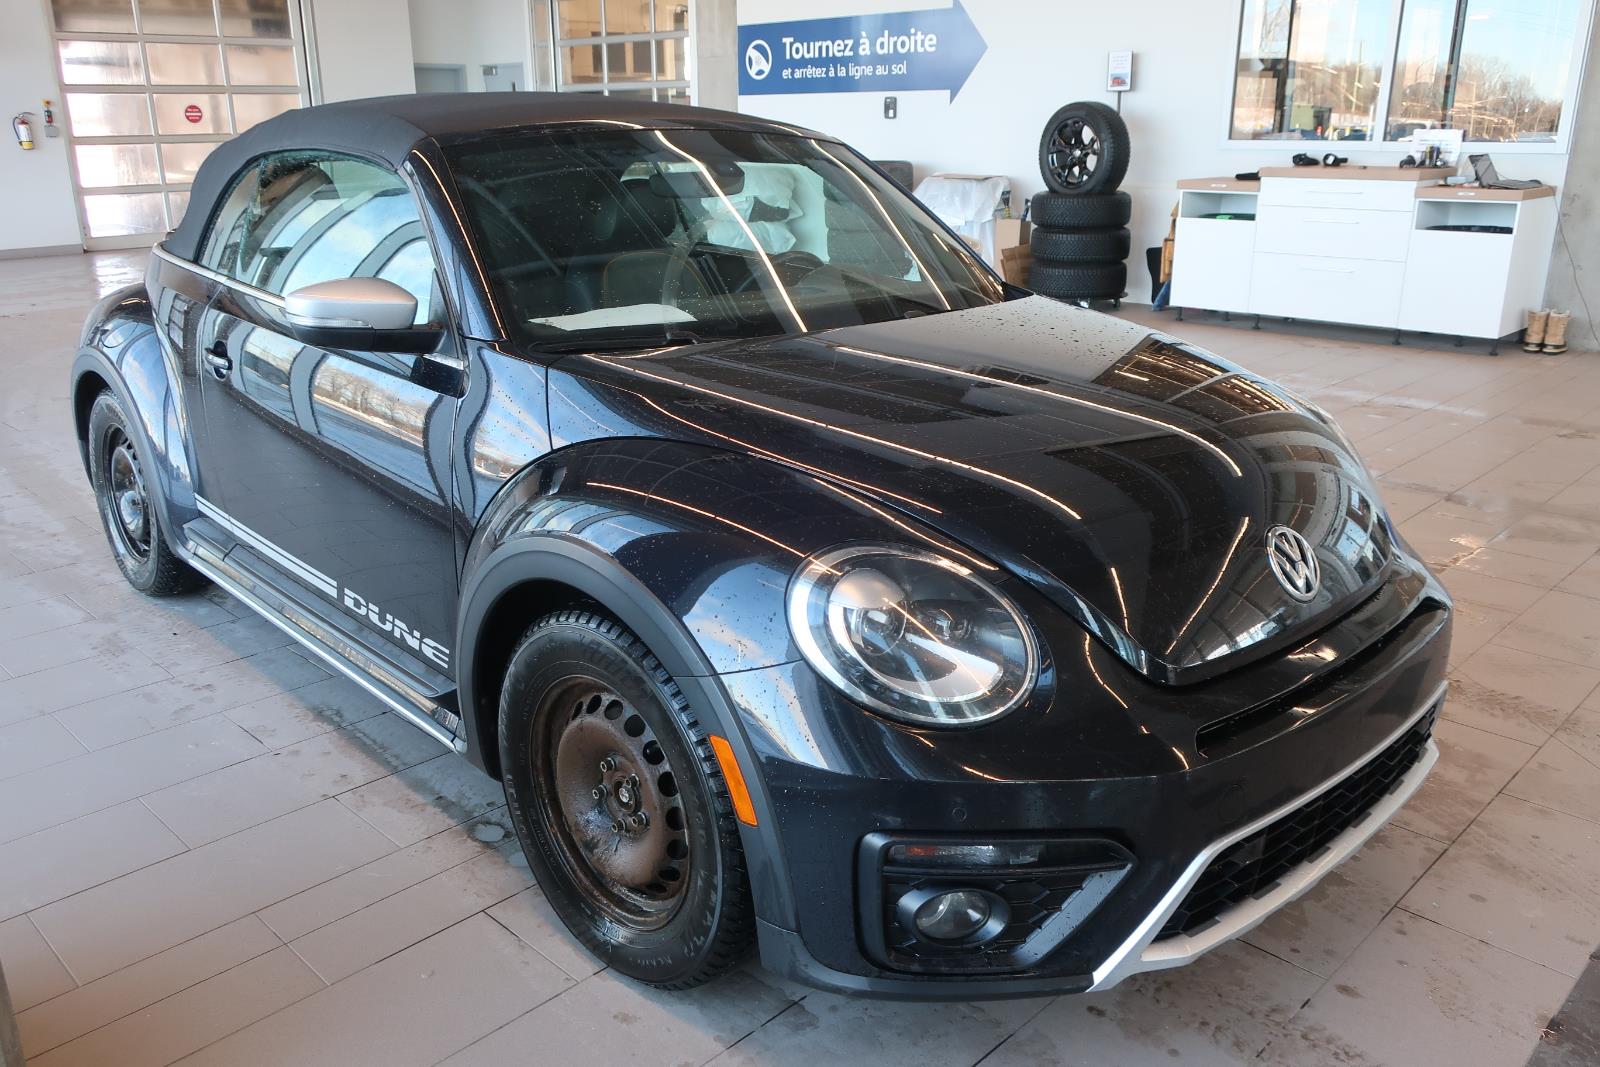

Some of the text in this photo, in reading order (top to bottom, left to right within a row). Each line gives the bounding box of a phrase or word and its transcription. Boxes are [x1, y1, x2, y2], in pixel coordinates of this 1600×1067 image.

[782, 28, 937, 60] Tournez à droite
[782, 60, 907, 79] et arrêtez à la ligne au sol
[344, 587, 450, 669] DUNE
